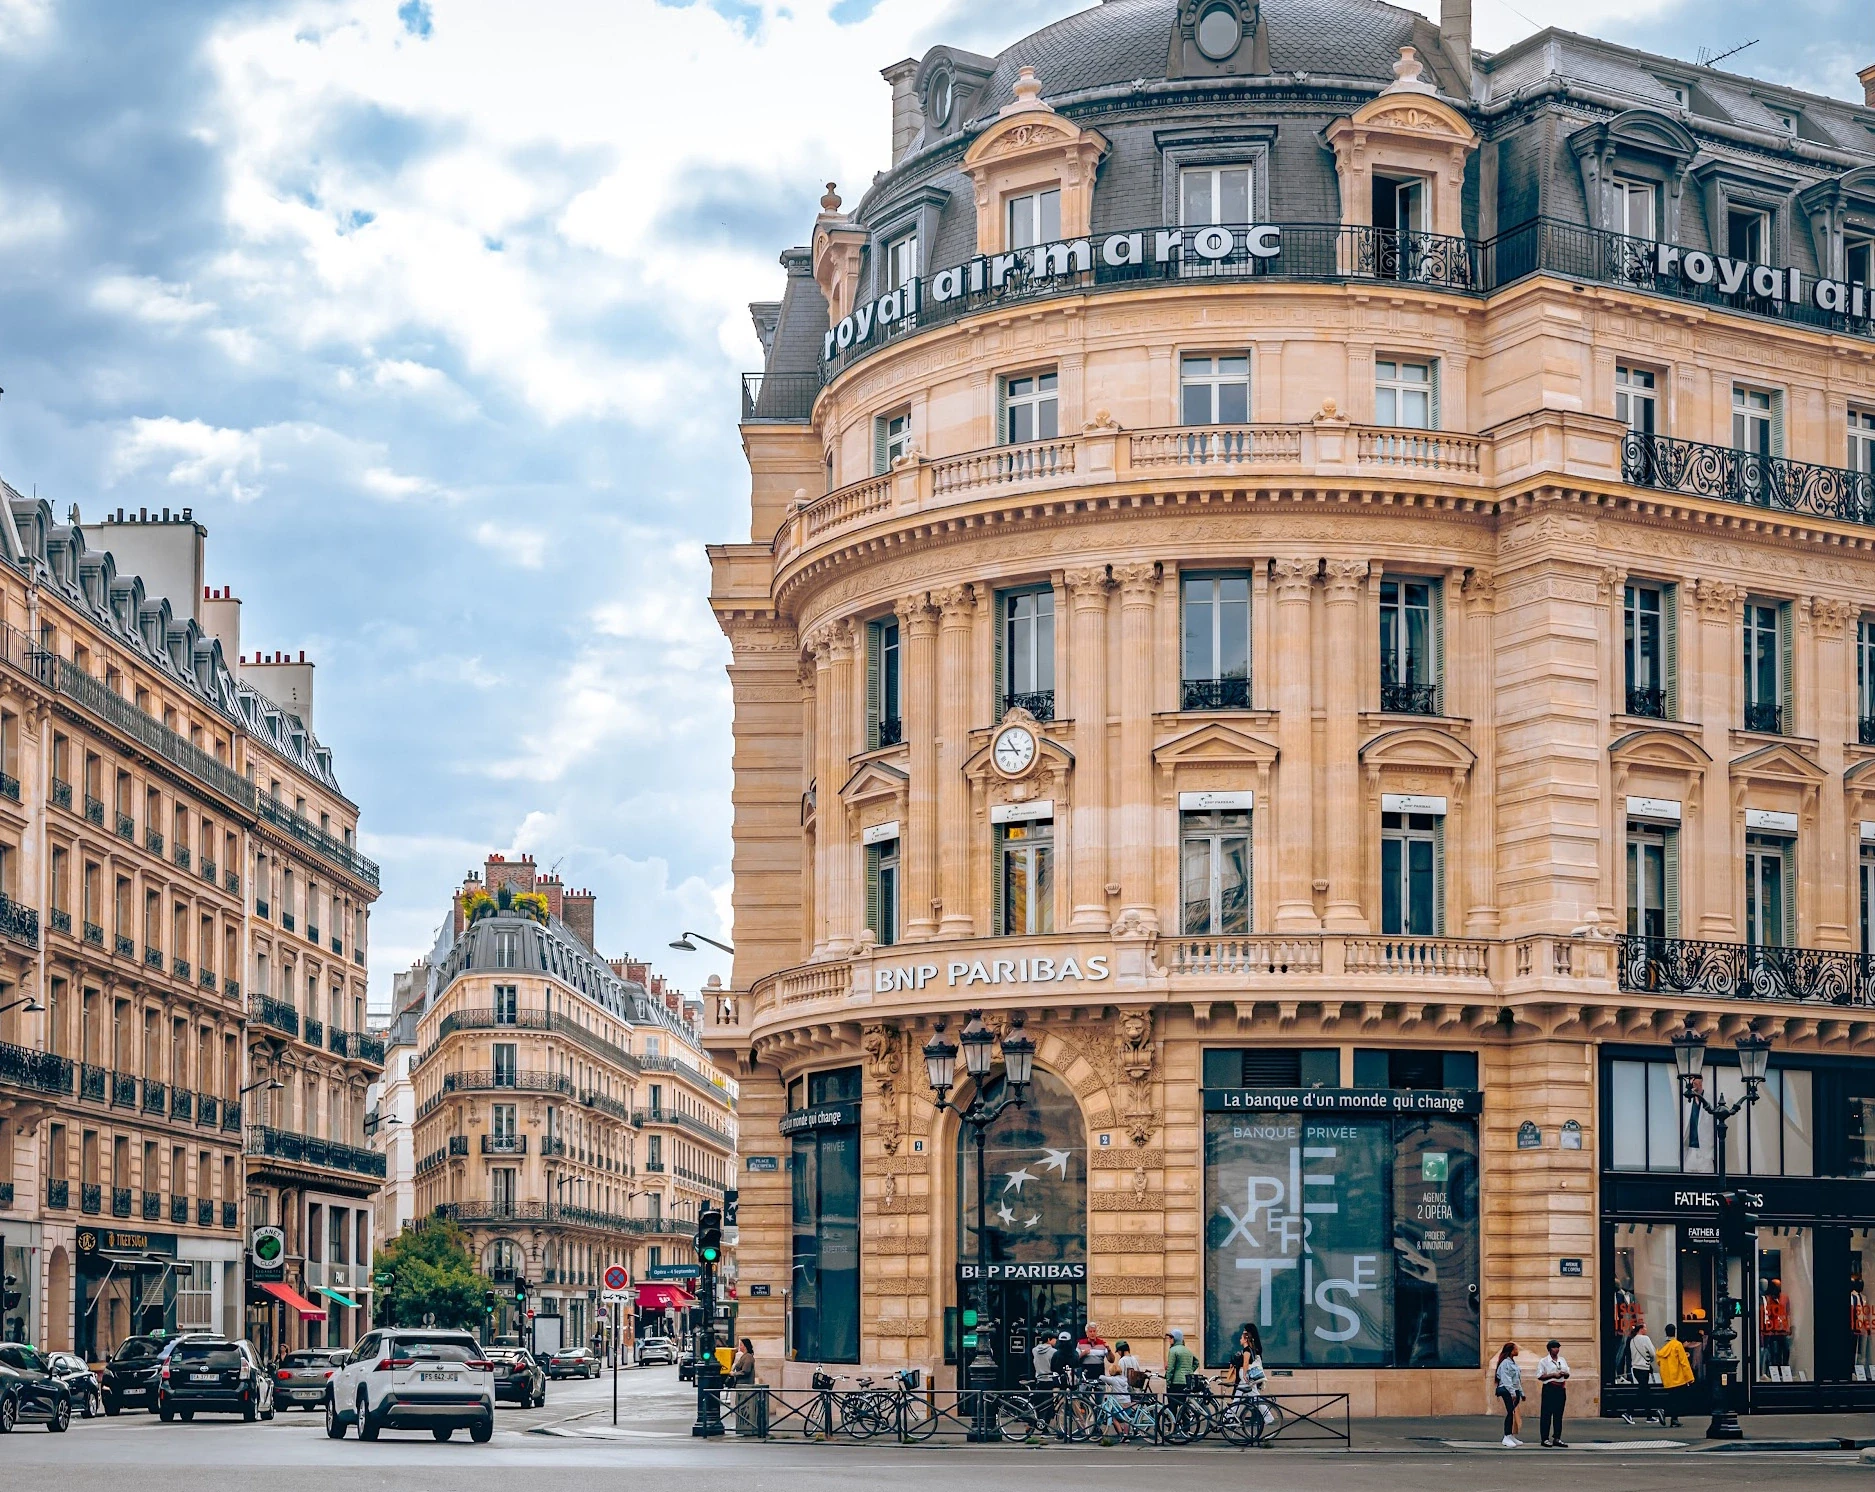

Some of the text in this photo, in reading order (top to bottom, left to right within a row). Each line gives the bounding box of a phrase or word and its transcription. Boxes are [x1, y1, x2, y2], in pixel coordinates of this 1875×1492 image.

[1656, 243, 1875, 321] royal ai
[825, 225, 1281, 361] royal air maroc
[876, 956, 1110, 993] BNP PARIBAS
[1224, 1093, 1464, 1113] La banque d'un monde qui change
[793, 1113, 808, 1128] monde
[808, 1112, 817, 1128] qui
[818, 1111, 841, 1126] change
[1233, 1125, 1357, 1140] BANQUE PRIVÉE
[822, 1140, 845, 1152] PRIVÉE
[916, 1141, 921, 1150] 2
[1102, 1135, 1108, 1144] 2
[1422, 1192, 1448, 1203] AGENCE
[1417, 1202, 1453, 1219] 2 OPÉRA
[256, 1229, 281, 1237] PLANET
[1424, 1230, 1446, 1240] PROJETS
[1688, 1227, 1715, 1237] FATHER
[117, 1233, 148, 1247] TIGER SUGAR
[1416, 1240, 1454, 1250] & INNOVATION
[335, 1271, 345, 1284] PMU
[1004, 1264, 1085, 1278] PARIBAS
